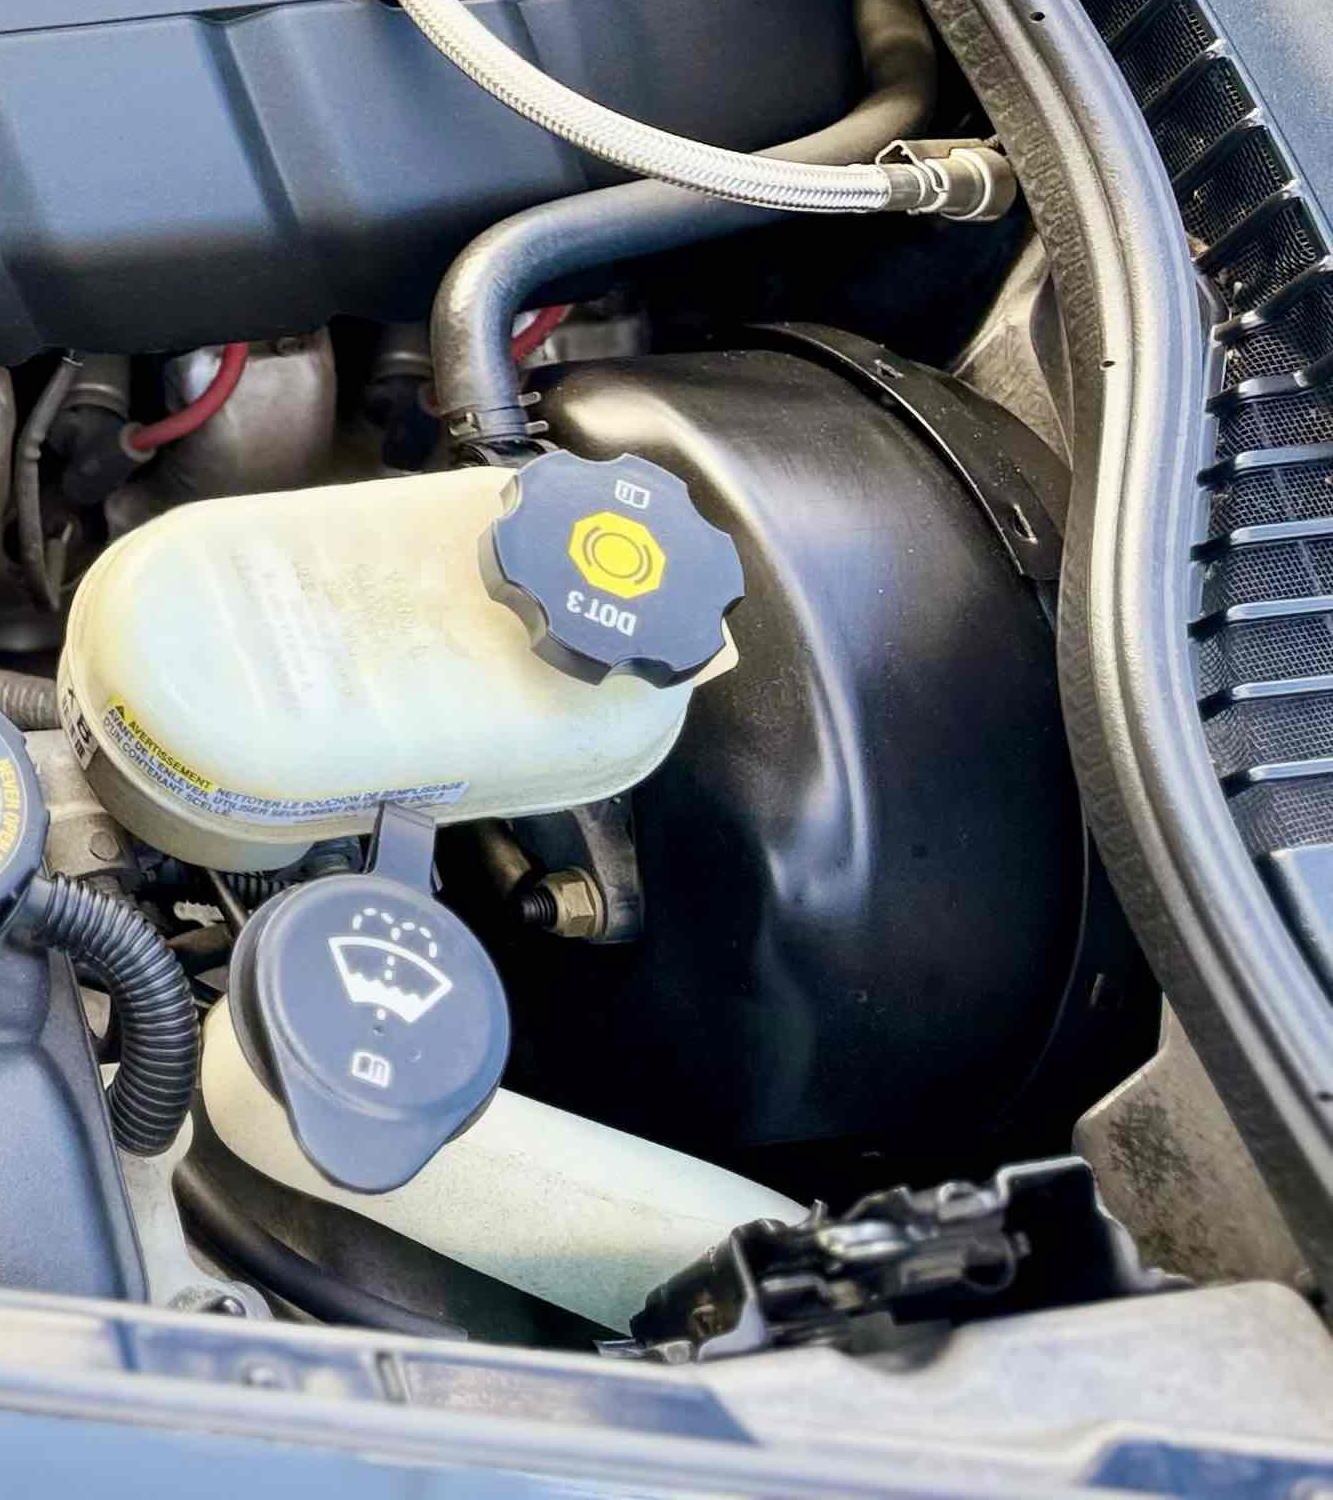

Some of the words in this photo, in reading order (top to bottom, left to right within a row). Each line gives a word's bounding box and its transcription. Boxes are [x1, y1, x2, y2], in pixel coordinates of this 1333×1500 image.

[565, 589, 585, 614] 3
[582, 597, 638, 637] DOT
[108, 708, 135, 742] AVANT
[103, 716, 123, 743] D'UN
[122, 741, 183, 796] CONTENANT
[128, 720, 213, 789] AVERTISSEMENT
